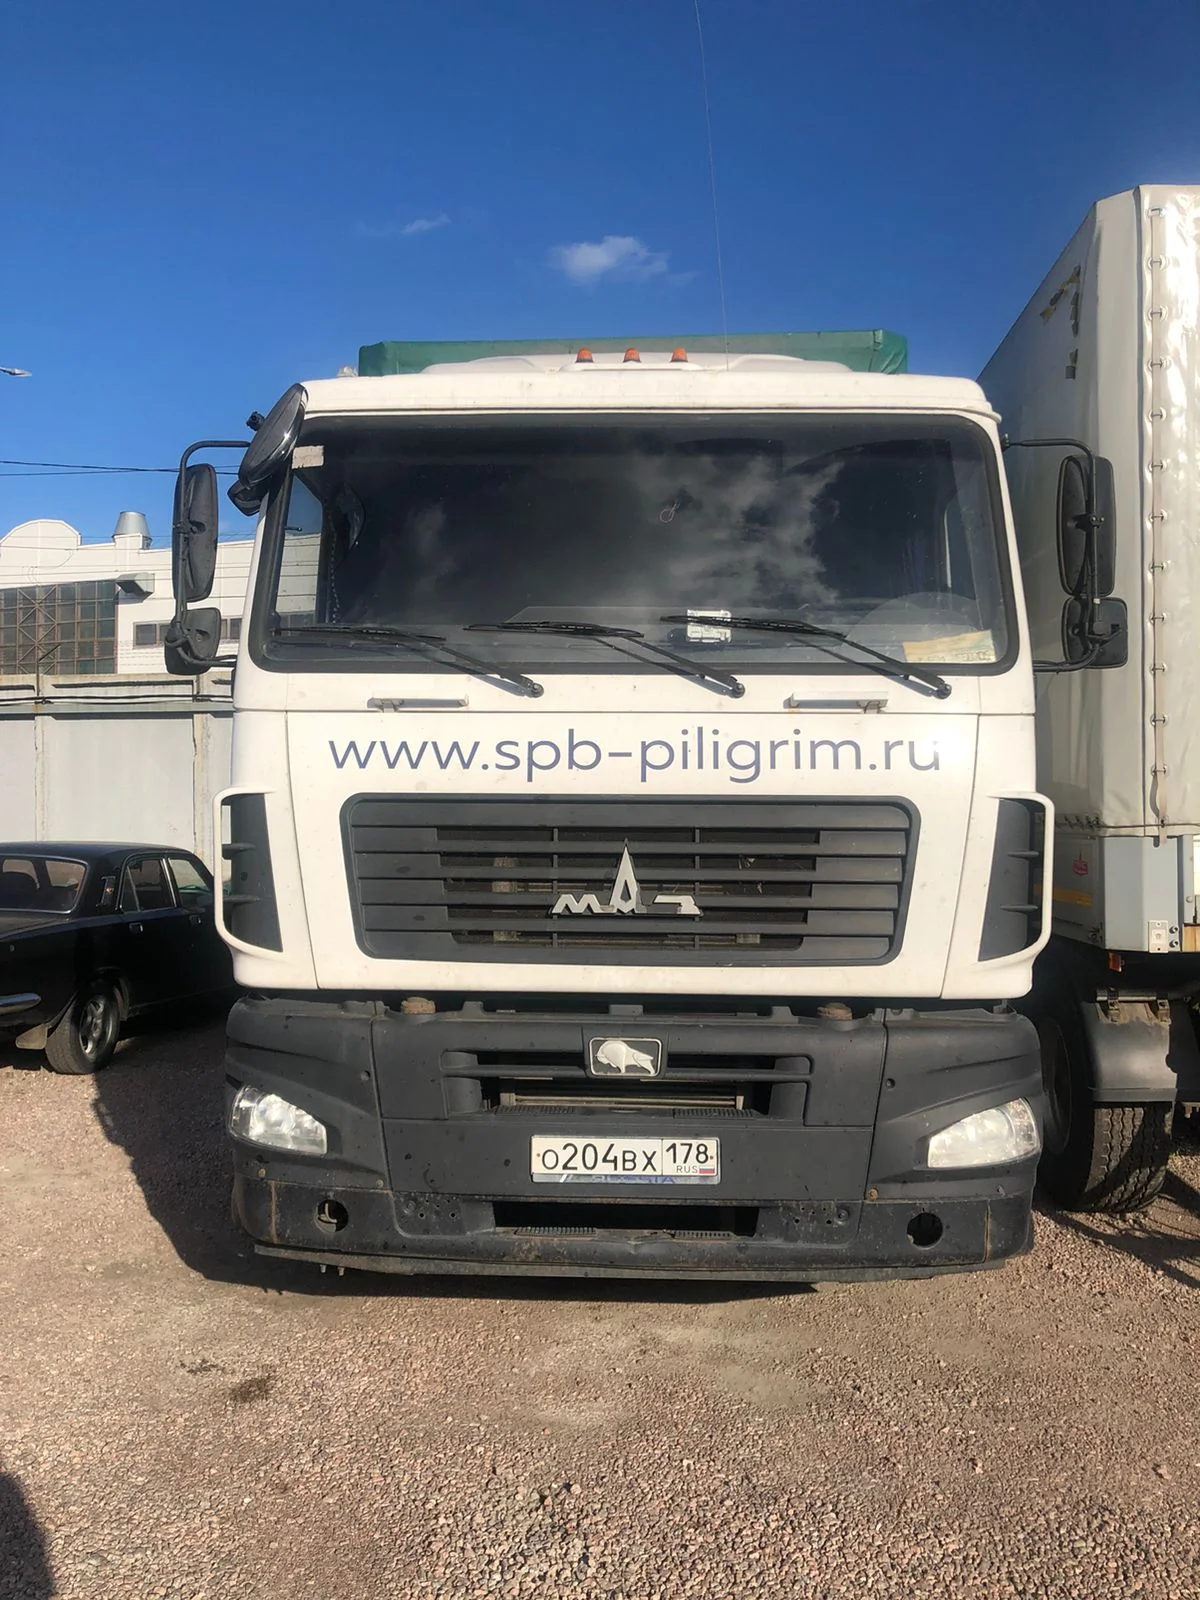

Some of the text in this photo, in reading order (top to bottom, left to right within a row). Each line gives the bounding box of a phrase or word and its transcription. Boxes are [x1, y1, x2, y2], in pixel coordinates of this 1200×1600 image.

[329, 728, 940, 783] www.spb-piligrim.ru
[665, 1142, 709, 1165] 178
[676, 1165, 698, 1174] RUS
